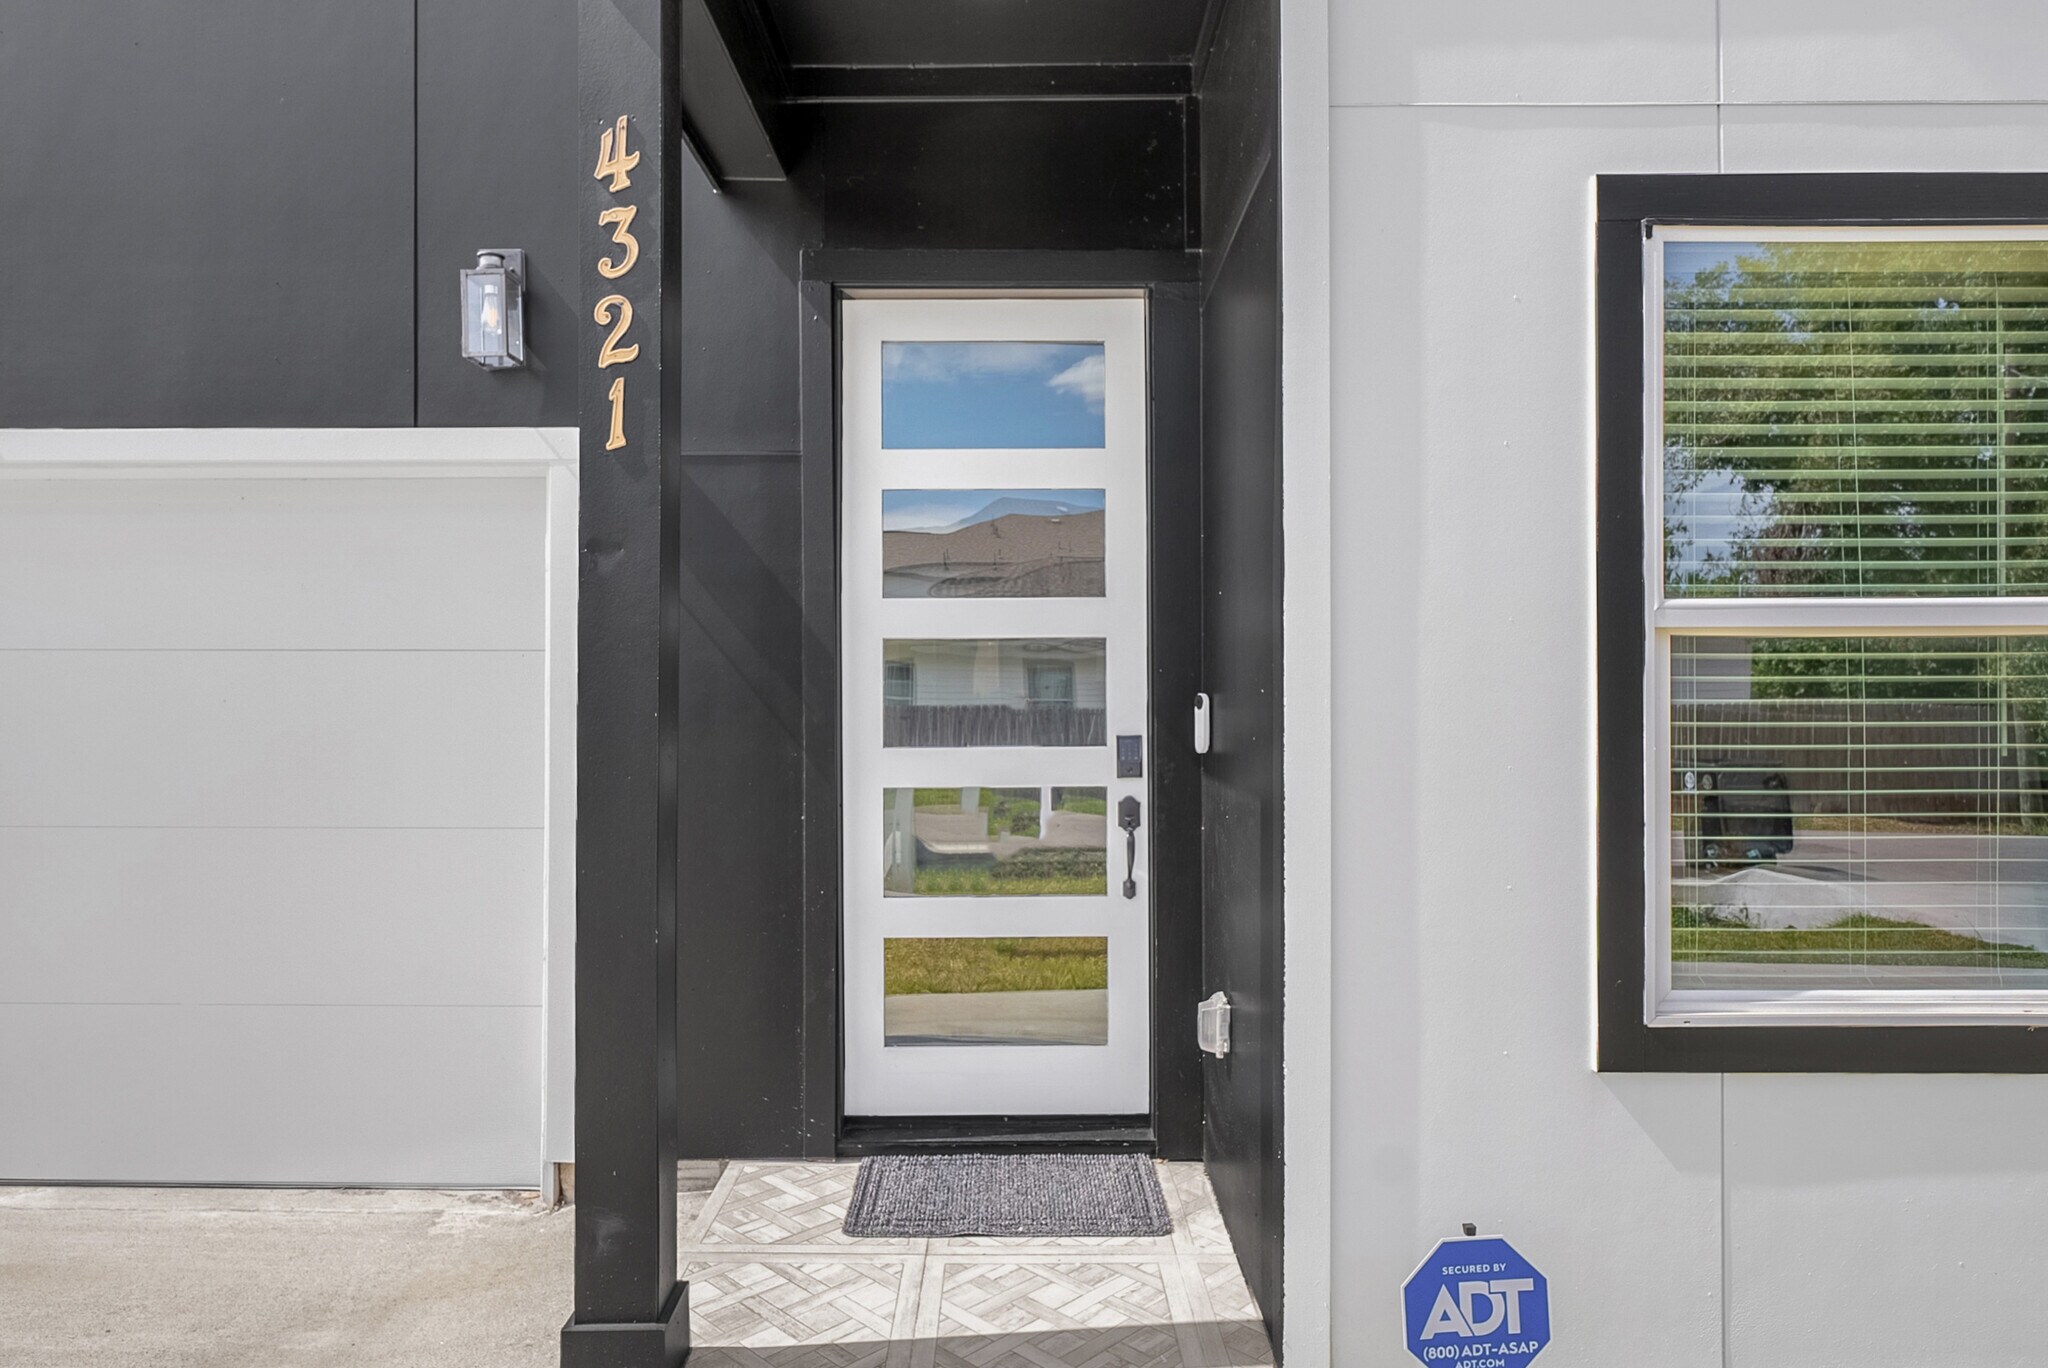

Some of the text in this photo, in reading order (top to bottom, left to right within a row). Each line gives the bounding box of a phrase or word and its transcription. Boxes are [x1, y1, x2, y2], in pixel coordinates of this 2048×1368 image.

[594, 115, 640, 451] 4321
[1442, 1263, 1506, 1275] SECURED BY
[1420, 1278, 1534, 1340] ADT
[1423, 1341, 1539, 1362] (800) ADT-ASAP
[1455, 1358, 1505, 1368] ADT.COM
